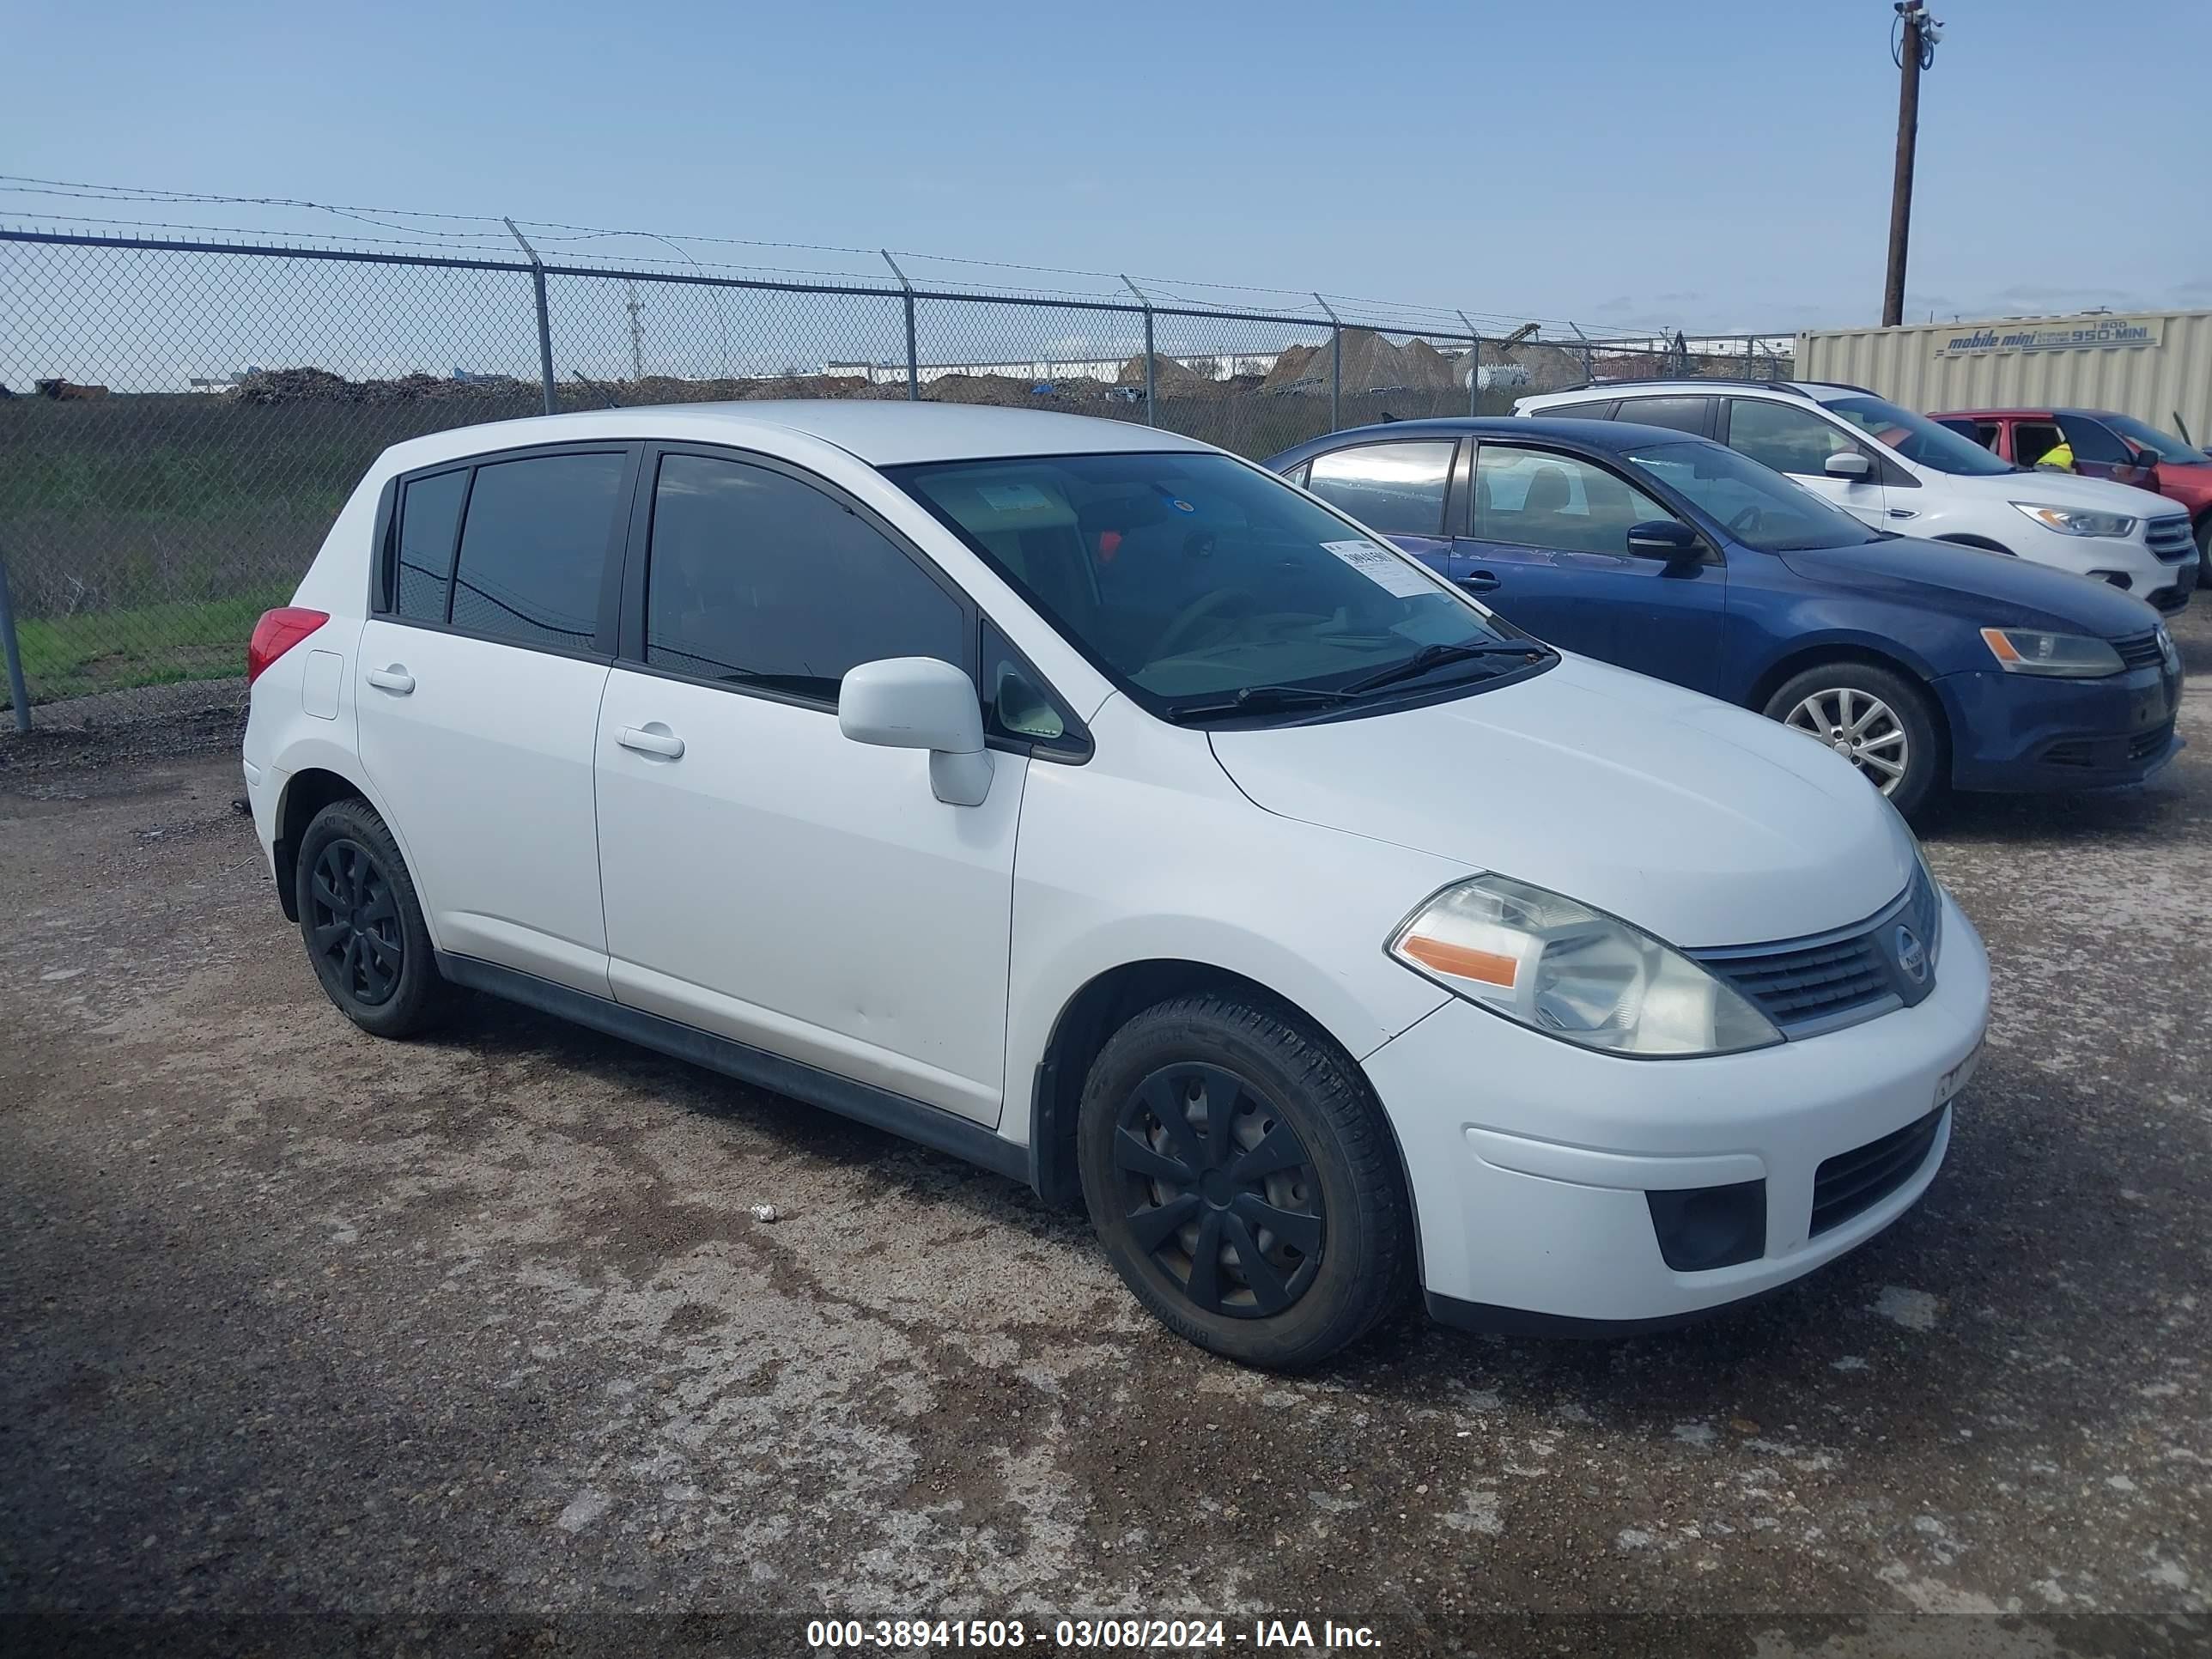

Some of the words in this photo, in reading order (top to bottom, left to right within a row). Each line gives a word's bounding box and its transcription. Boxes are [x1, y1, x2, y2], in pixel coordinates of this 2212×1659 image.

[1948, 329, 1999, 349] mobile
[2001, 331, 2038, 346] mini
[2072, 327, 2148, 341] 950-MINI
